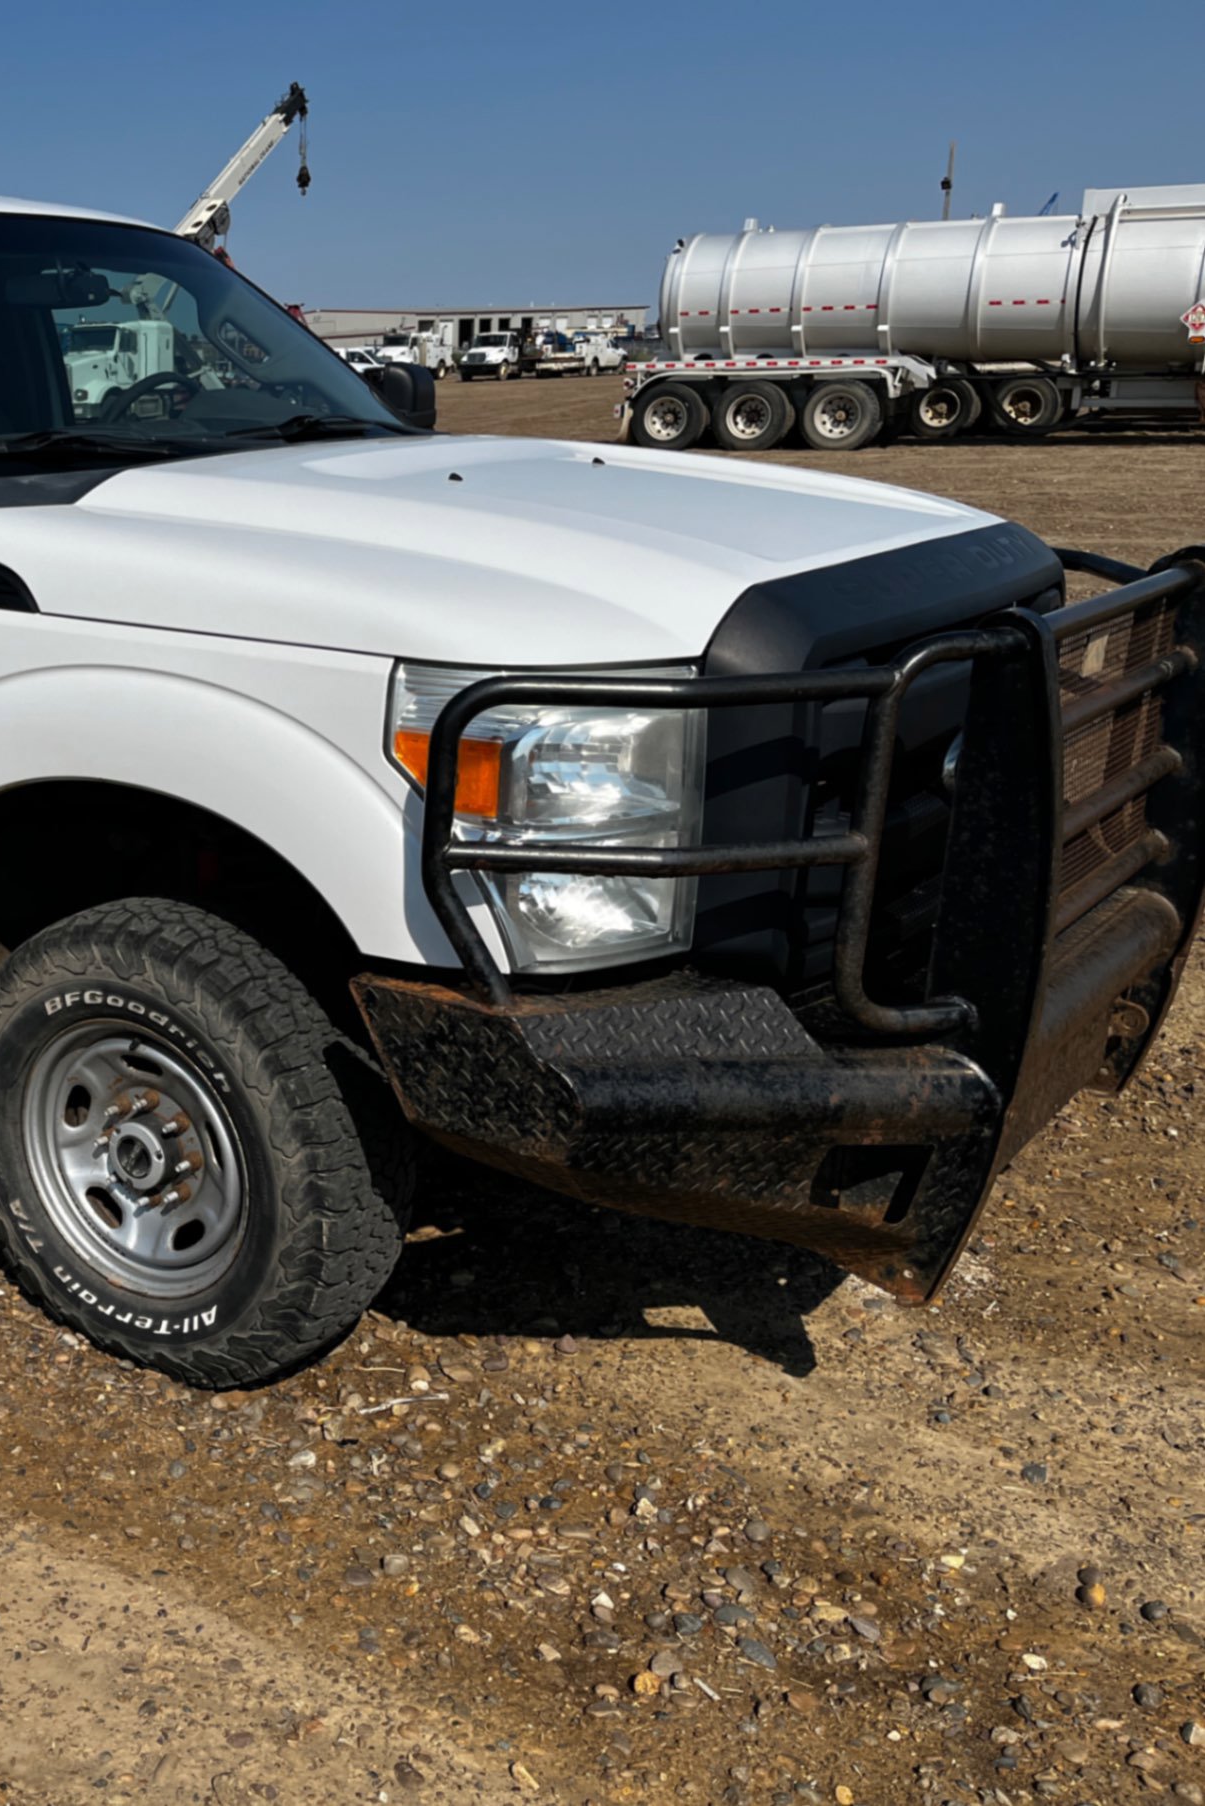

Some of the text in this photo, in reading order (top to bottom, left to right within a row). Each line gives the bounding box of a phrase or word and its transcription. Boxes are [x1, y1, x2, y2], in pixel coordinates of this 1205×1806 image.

[969, 533, 1035, 570] DUTY
[44, 990, 231, 1093] BFGoodrich
[53, 1265, 218, 1335] All-Terrain
